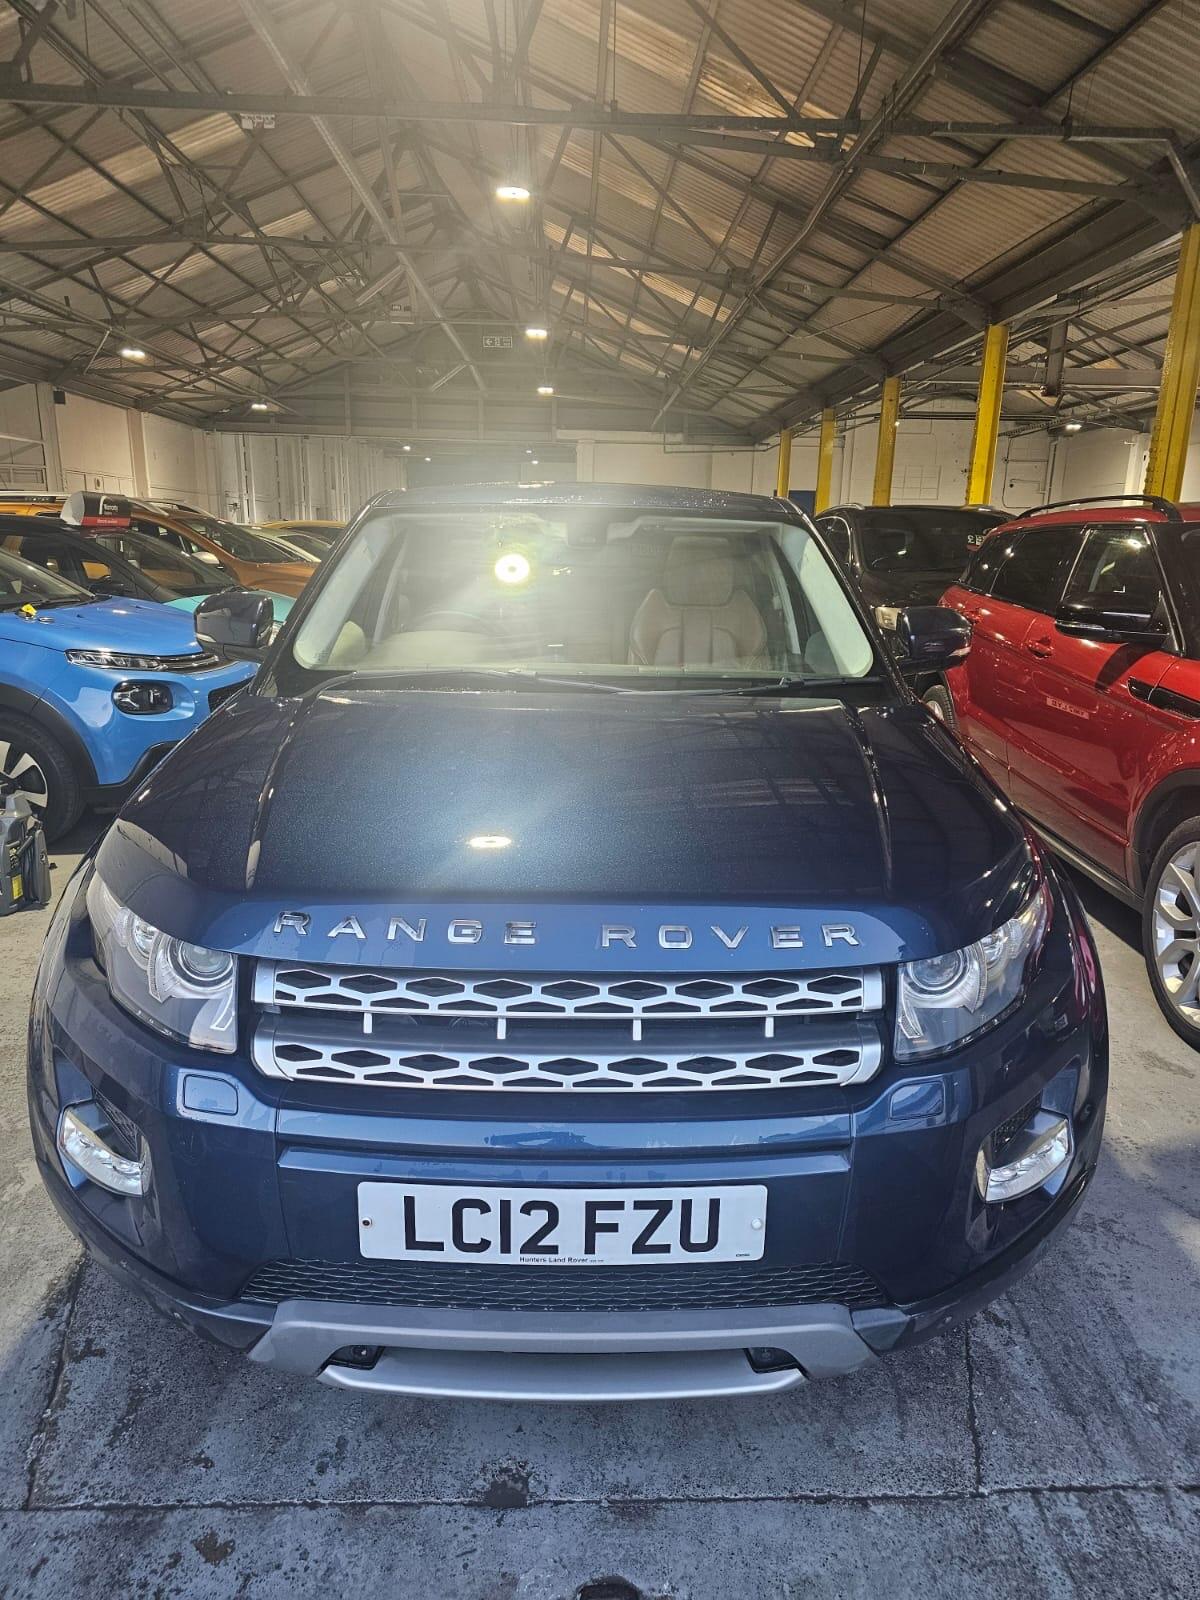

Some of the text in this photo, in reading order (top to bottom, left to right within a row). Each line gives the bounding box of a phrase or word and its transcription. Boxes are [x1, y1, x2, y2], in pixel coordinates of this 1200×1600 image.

[272, 910, 861, 949] RANGE ROVER
[403, 1195, 722, 1255] LC12 FZU
[519, 1256, 547, 1264] Hunters
[548, 1256, 566, 1264] Land
[567, 1256, 589, 1264] Rover
